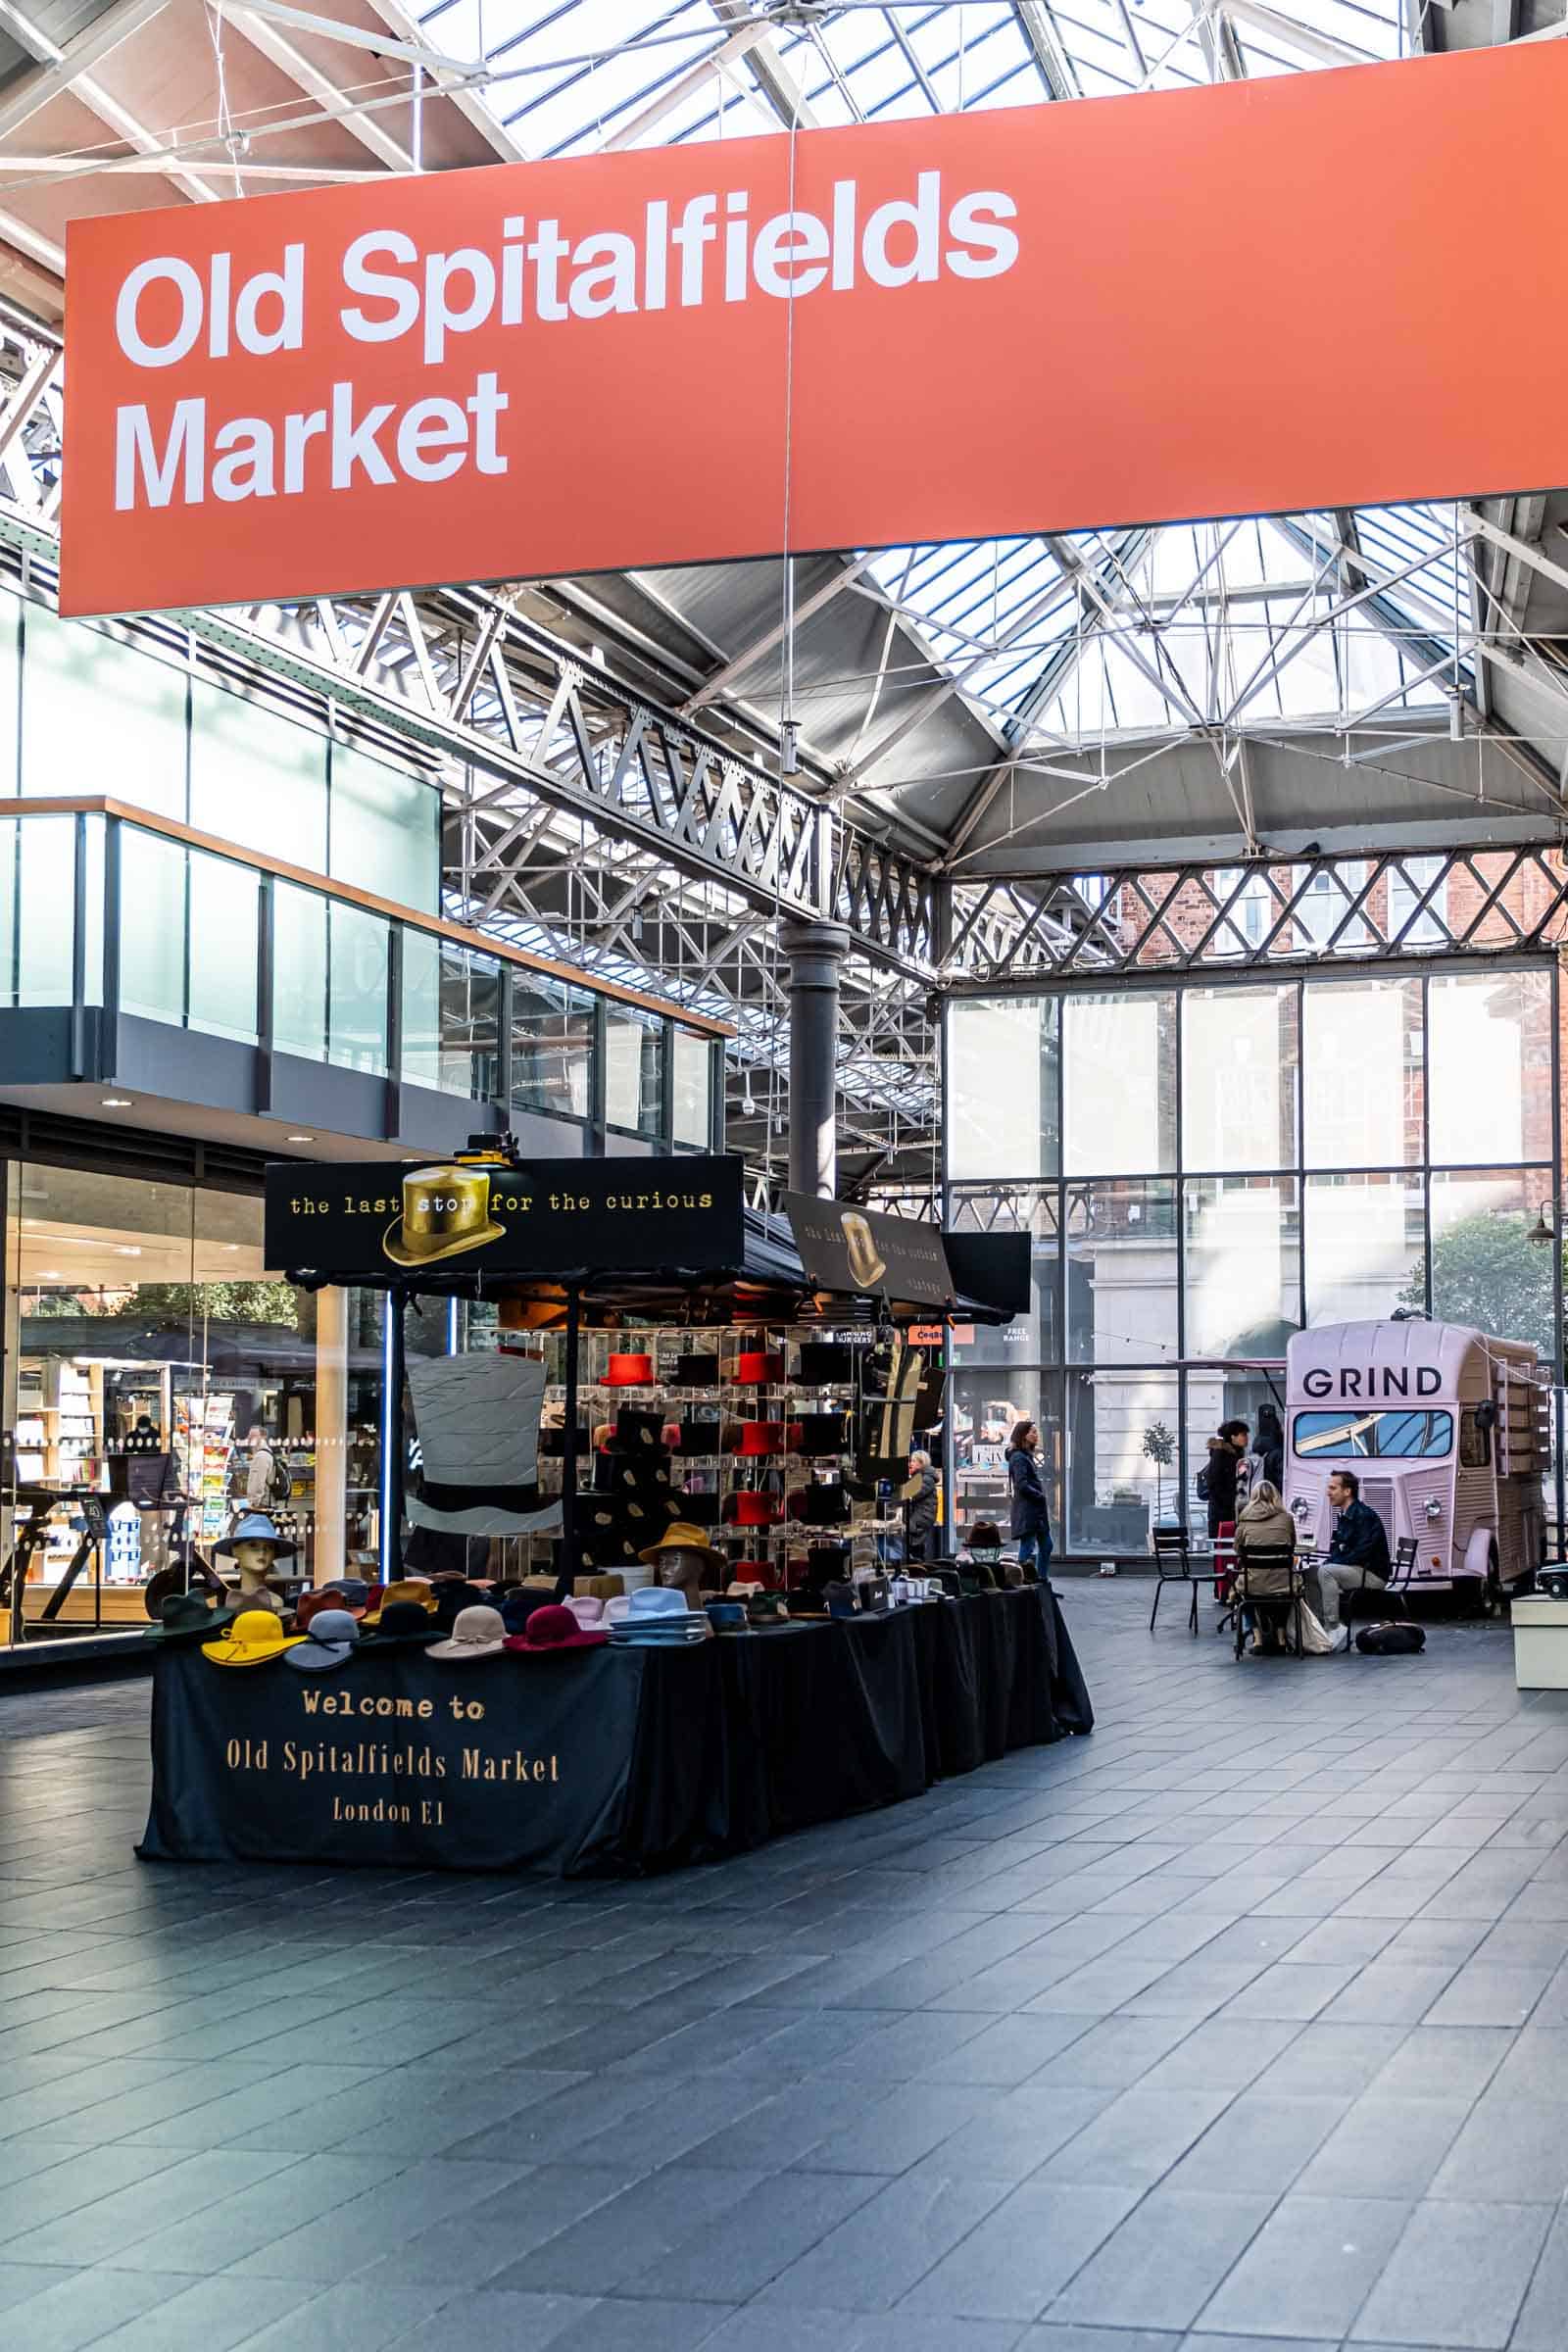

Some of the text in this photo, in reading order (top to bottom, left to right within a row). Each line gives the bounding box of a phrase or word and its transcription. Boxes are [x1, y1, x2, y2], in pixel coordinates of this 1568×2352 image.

[115, 170, 1020, 368] Old Spitalfields
[115, 371, 510, 512] Market
[290, 1190, 713, 1217] the last stop for the curious
[1302, 1366, 1443, 1398] GRIND
[302, 1690, 486, 1721] Welcome to
[226, 1738, 560, 1783] Old Spitalfields Market
[333, 1796, 412, 1825] London
